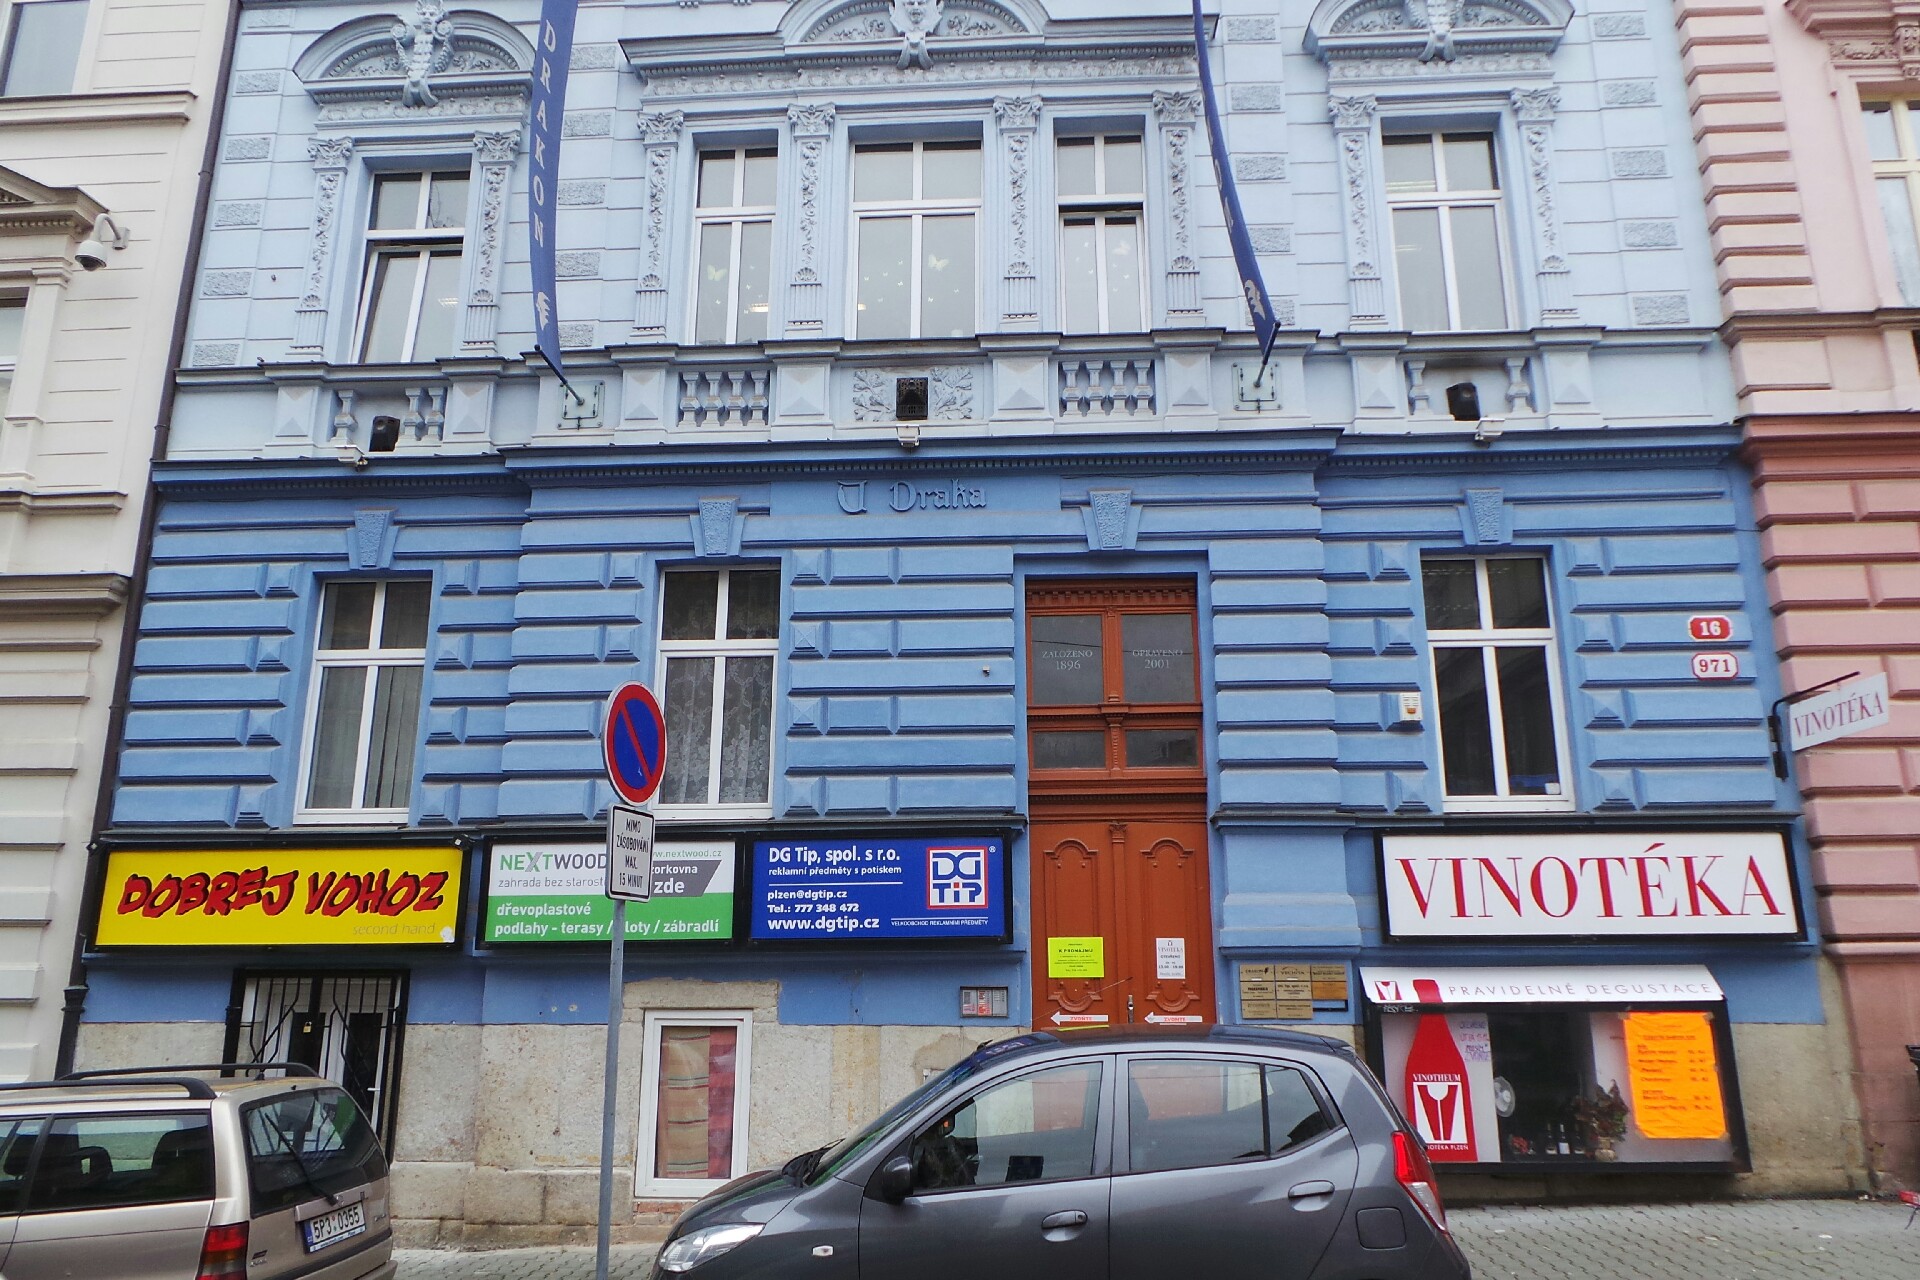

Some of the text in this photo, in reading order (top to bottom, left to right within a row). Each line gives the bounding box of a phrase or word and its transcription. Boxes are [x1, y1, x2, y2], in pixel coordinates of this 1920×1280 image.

[533, 20, 557, 249] DRAKON
[889, 478, 987, 512] Draka
[1700, 621, 1721, 636] 16
[1042, 649, 1093, 658] ZALOŽENO
[1132, 649, 1183, 657] OPRAVENO
[1056, 660, 1081, 670] 1896
[1144, 659, 1170, 669] 2001
[1699, 659, 1731, 673] 971
[1793, 691, 1884, 738] VINOTÉKA
[625, 818, 641, 833] MIMO
[616, 832, 649, 853] ZÁSOBOVÁNÍ
[769, 845, 900, 866] DG Tip, spol. s r.o.
[651, 865, 698, 874] zorkovna
[768, 867, 807, 876] reklamní
[809, 866, 852, 876] předměty
[861, 865, 902, 876] potiskem
[498, 877, 605, 888] zahrada bez starost
[619, 873, 643, 888] 15 MINUT
[653, 878, 685, 894] zde
[1394, 843, 1786, 919] VINOTÉKA
[117, 865, 449, 918] DOBREJ VOHOZ
[767, 890, 848, 901] plzen@dgtip.cz
[497, 902, 591, 918] dřevoplastové
[767, 903, 859, 913] Tel.: 777 348 472
[352, 923, 435, 935] second hand
[494, 922, 548, 937] podlahy
[561, 923, 604, 936] terasy
[624, 920, 651, 935] loty
[653, 919, 661, 934] /
[663, 918, 720, 933] zábradlí
[767, 916, 880, 932] www.dgtip.cz
[1448, 983, 1711, 996] PRAVIDELNÉ DEGUSTACE
[1412, 1074, 1461, 1082] VINOTHEUM
[313, 1218, 331, 1239] 5P3
[338, 1206, 359, 1230] 0355
